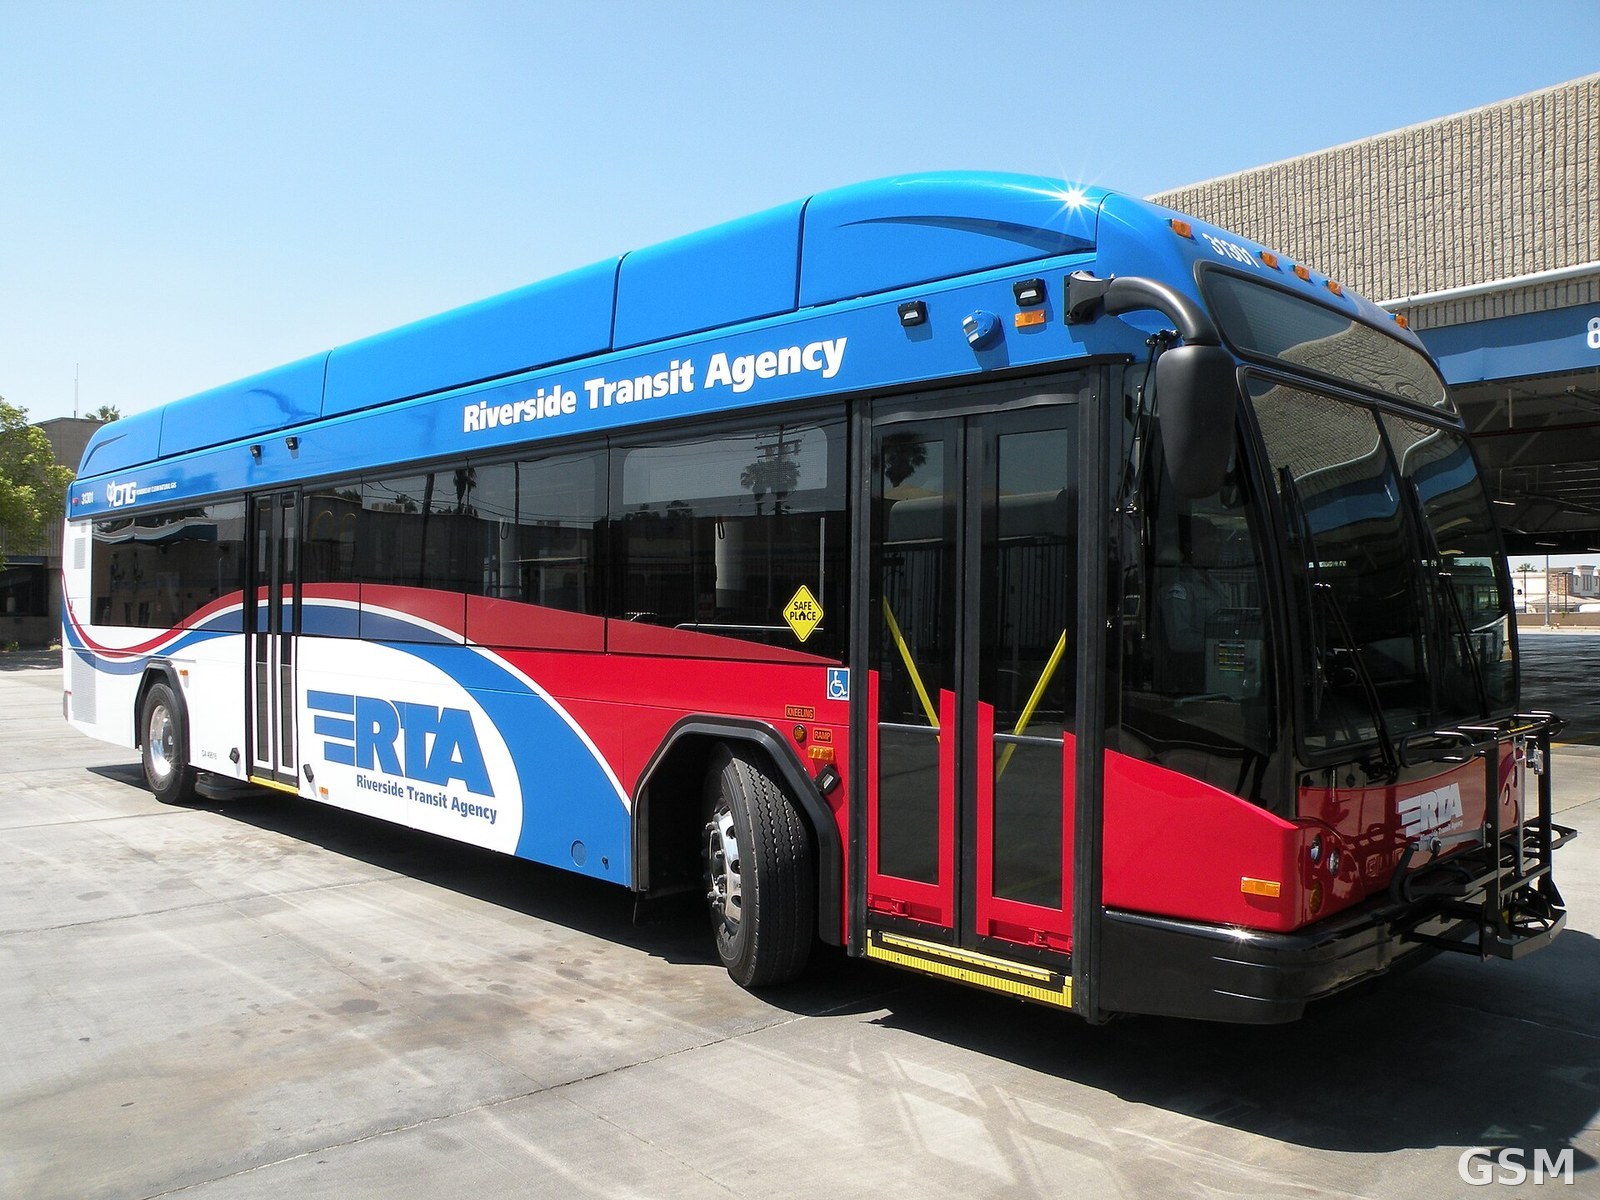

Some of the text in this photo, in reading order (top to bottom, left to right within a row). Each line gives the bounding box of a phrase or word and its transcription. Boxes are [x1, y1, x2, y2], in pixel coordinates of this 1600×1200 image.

[1202, 233, 1260, 269] 31301
[463, 337, 848, 433] Riverside Transit Agency
[793, 601, 812, 611] SAFE
[786, 706, 815, 719] KNEELING
[814, 729, 831, 741] RAMP
[356, 774, 498, 824] Riverside Transit Agency
